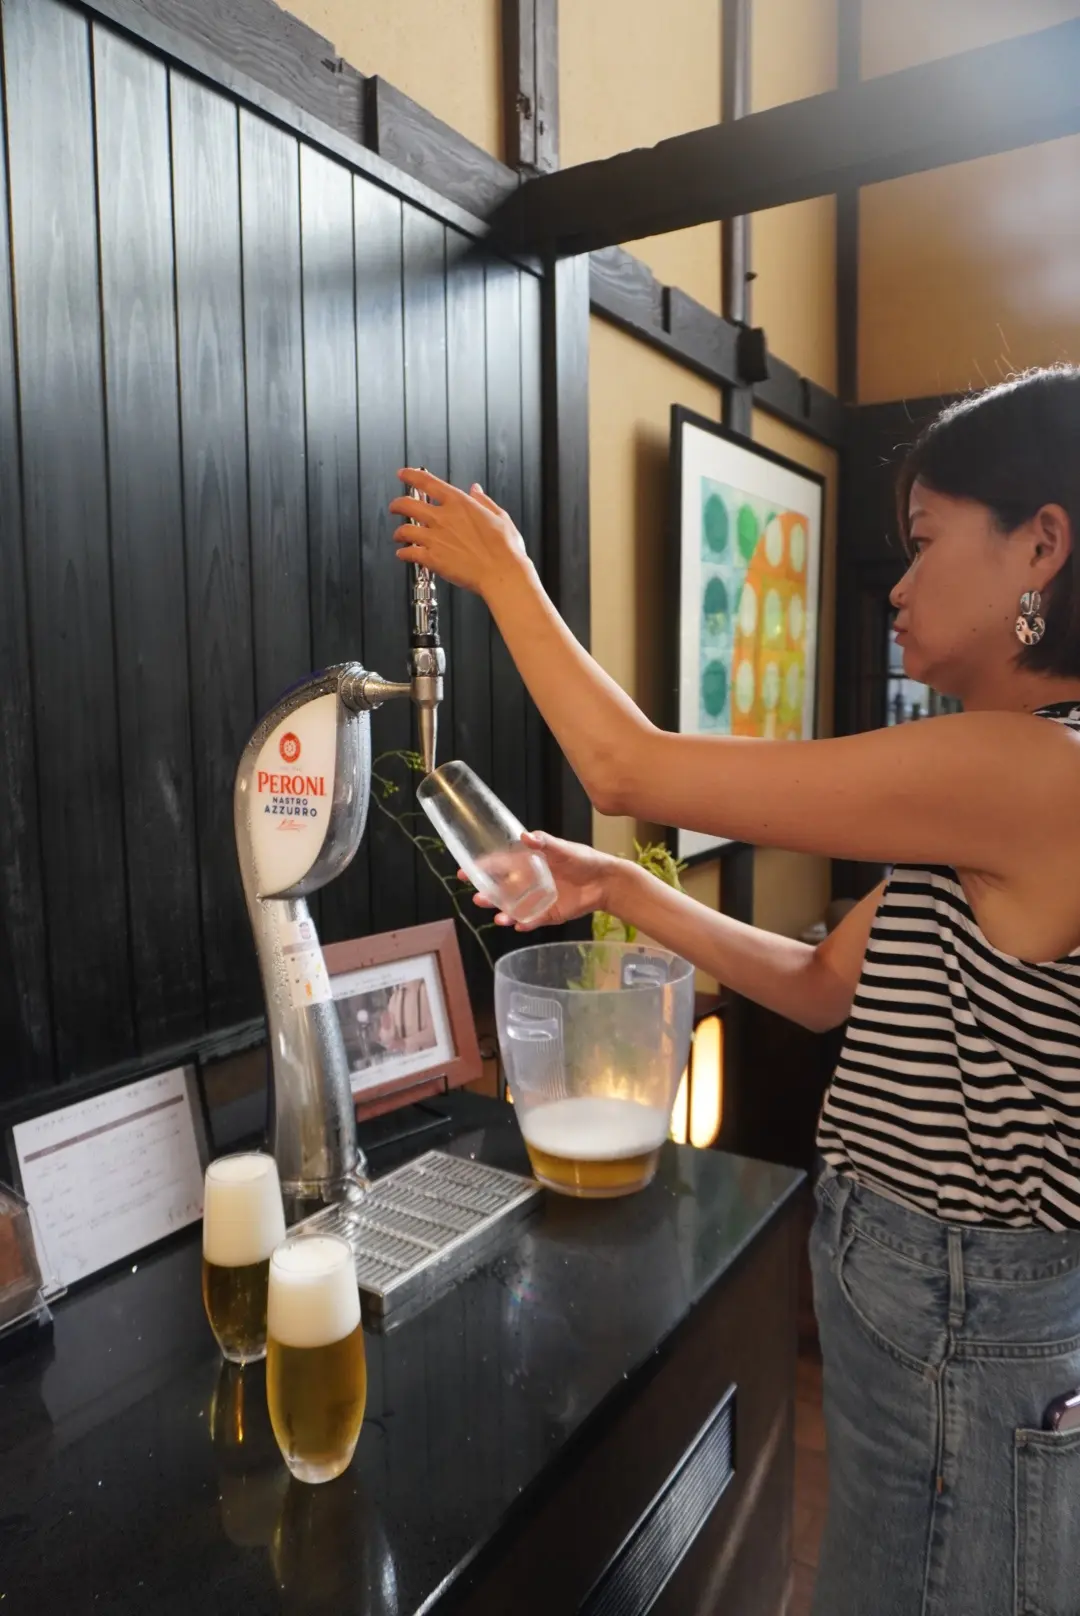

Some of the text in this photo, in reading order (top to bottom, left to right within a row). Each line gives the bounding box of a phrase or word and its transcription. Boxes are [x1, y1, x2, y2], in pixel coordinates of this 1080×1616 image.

[257, 771, 325, 796] PERONI
[272, 796, 308, 806] NASTRO
[264, 805, 318, 817] AZZURRO
